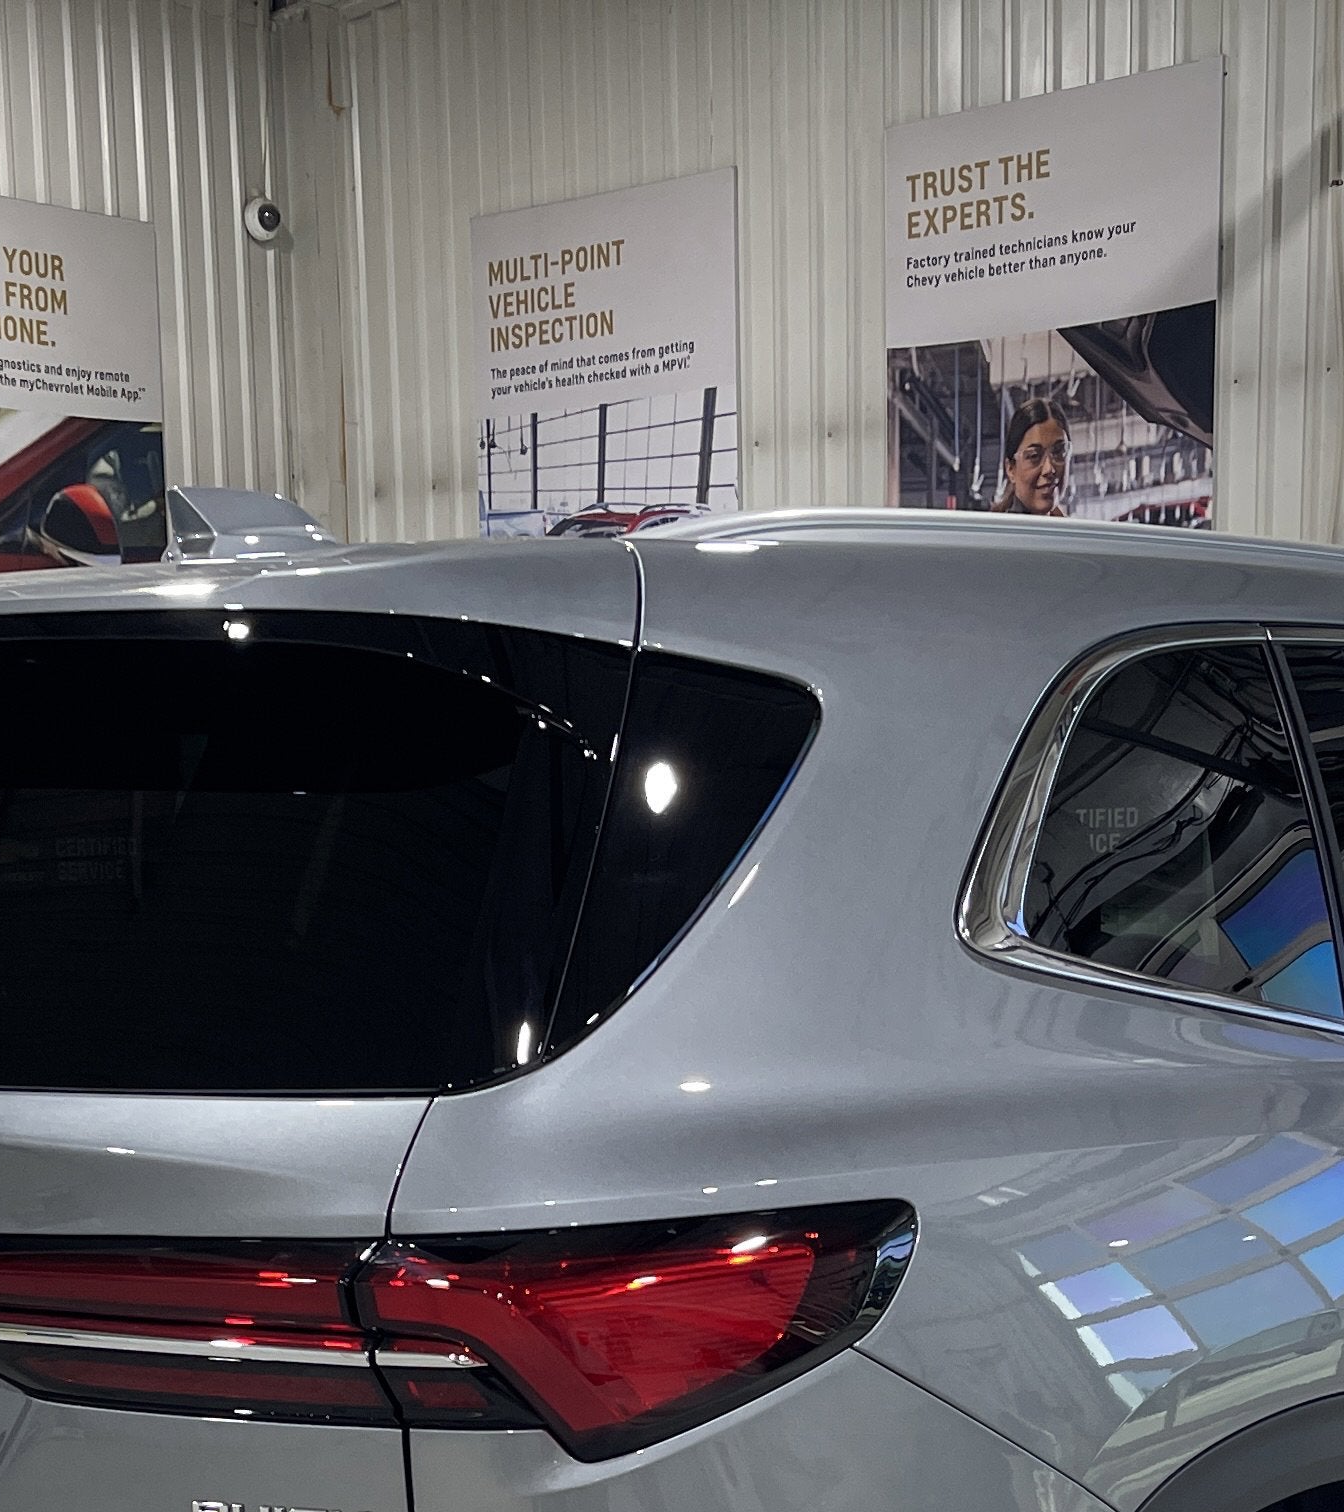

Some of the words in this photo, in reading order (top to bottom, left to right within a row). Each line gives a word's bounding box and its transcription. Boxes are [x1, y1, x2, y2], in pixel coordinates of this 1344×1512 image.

[906, 160, 990, 202] TRUST
[998, 148, 1050, 185] THE
[907, 192, 1034, 239] EXPERTS.
[3, 246, 64, 281] YOUR
[488, 239, 625, 286] MULTI-POINT
[906, 253, 951, 271] Factory
[954, 244, 996, 263] trained
[999, 233, 1068, 256] technicians
[1071, 227, 1104, 243] know
[1107, 220, 1136, 241] your
[906, 272, 941, 289] Chevy
[944, 266, 985, 283] vehicle
[988, 260, 1026, 277] better
[1029, 255, 1056, 271] than
[1059, 247, 1107, 267] anyone.
[5, 281, 68, 315] FROM
[488, 282, 575, 319] VEHICLE
[490, 310, 614, 352] INSPECTION
[44, 363, 62, 376] and
[66, 367, 91, 382] enjoy
[95, 371, 130, 383] remote
[491, 367, 507, 381] The
[510, 364, 536, 381] peace
[539, 361, 548, 373] of
[551, 357, 574, 372] mind
[576, 354, 596, 368] that
[598, 350, 630, 364] comes
[632, 347, 655, 360] from
[658, 341, 695, 358] getting
[491, 385, 512, 399] your
[514, 377, 553, 393] vehicle's
[555, 372, 585, 388] health
[587, 367, 627, 383] checked
[629, 363, 651, 377] with
[653, 364, 659, 373] a
[0, 374, 16, 386] the
[20, 377, 83, 396] myChevrolet
[87, 385, 117, 398] Mobile
